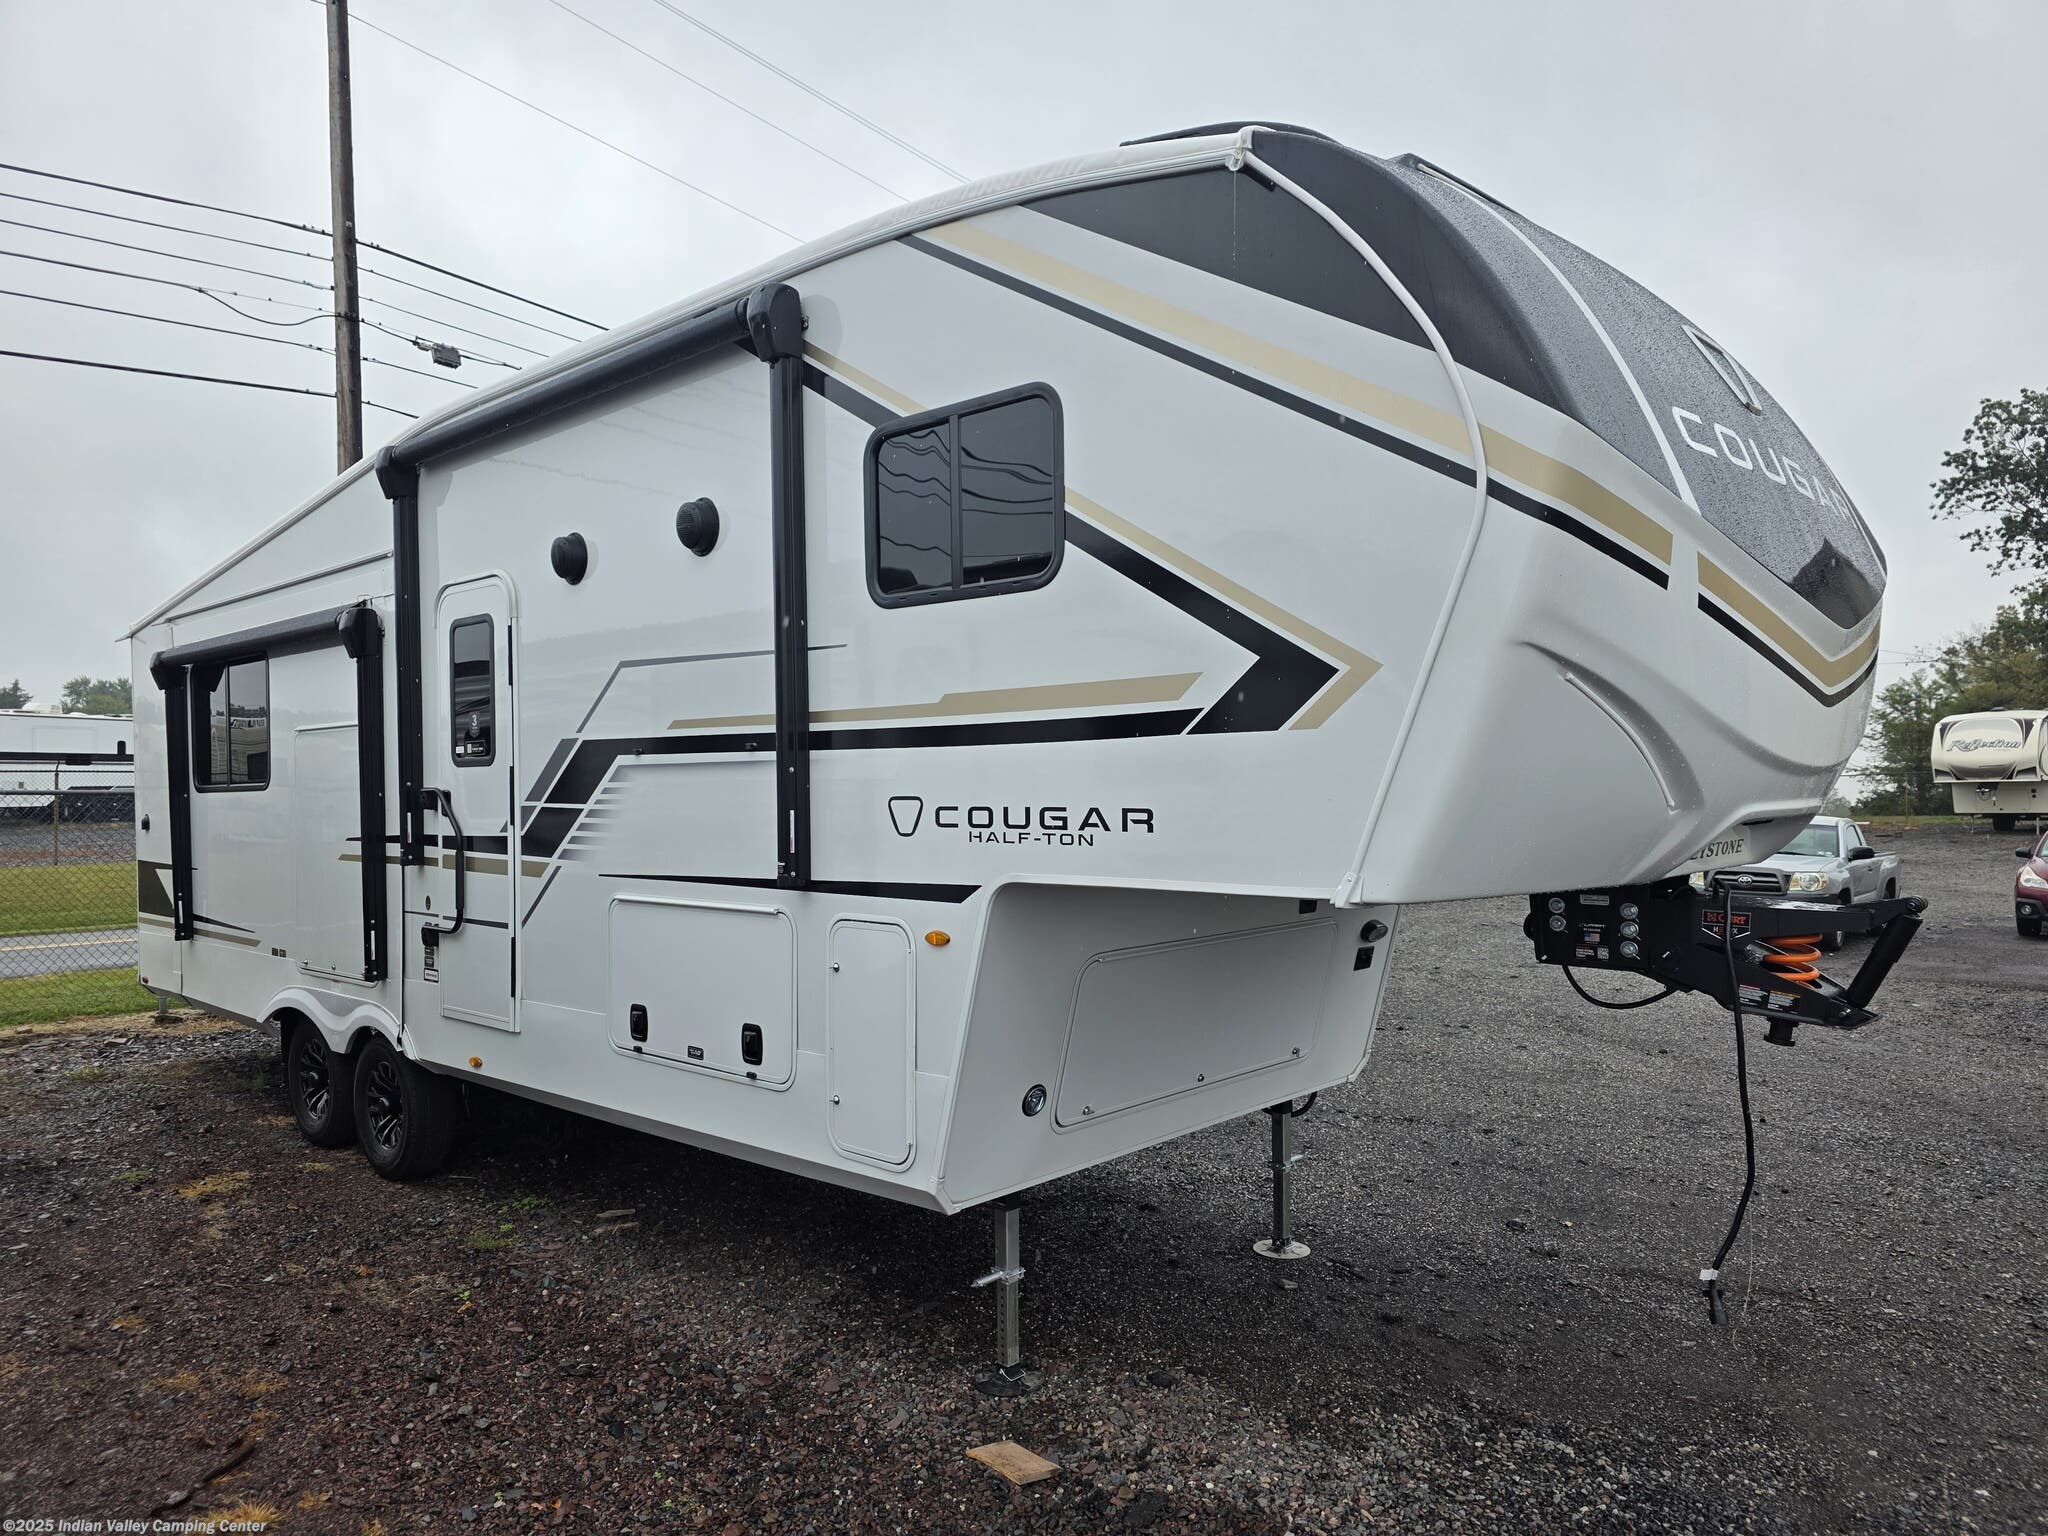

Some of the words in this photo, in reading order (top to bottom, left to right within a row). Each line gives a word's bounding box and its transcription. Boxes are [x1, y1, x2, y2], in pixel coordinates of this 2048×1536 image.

[1672, 407, 1857, 527] COUGAR
[1946, 738, 2021, 752] Reflection
[935, 805, 1154, 834] COUGAR
[969, 831, 1093, 847] HALF-TON
[1690, 838, 1745, 860] YSTONE
[1717, 912, 1746, 924] CRT
